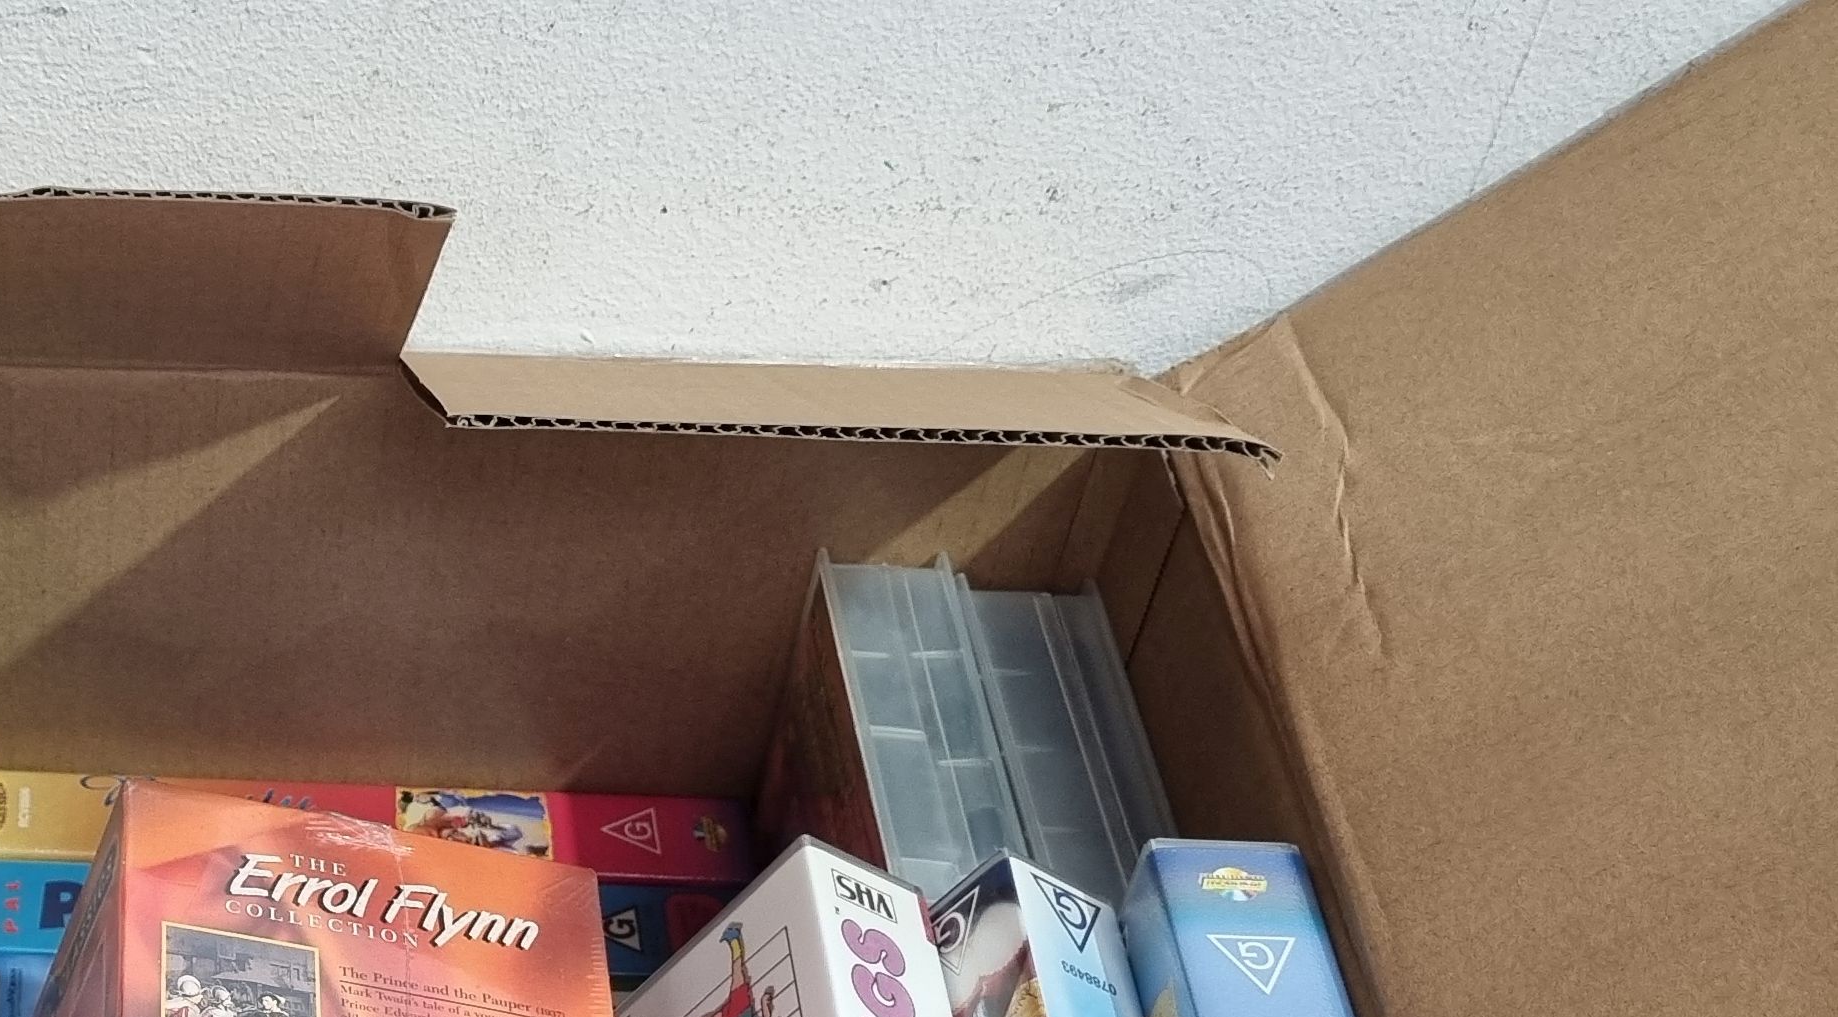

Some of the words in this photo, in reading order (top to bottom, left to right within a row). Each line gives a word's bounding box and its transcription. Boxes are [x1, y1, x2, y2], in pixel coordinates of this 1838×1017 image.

[624, 821, 652, 840] G
[290, 853, 347, 876] THE
[228, 853, 379, 917] Errol
[381, 883, 541, 951] Flynn
[1056, 894, 1087, 929] G
[225, 899, 419, 949] COLLECTION
[603, 919, 636, 939] G
[1238, 941, 1275, 970] G
[339, 966, 368, 981] The
[373, 971, 418, 990] Prince
[423, 982, 449, 998] and
[454, 987, 477, 1002] the
[482, 992, 532, 1013] Pauper
[1061, 959, 1116, 995] 0788493
